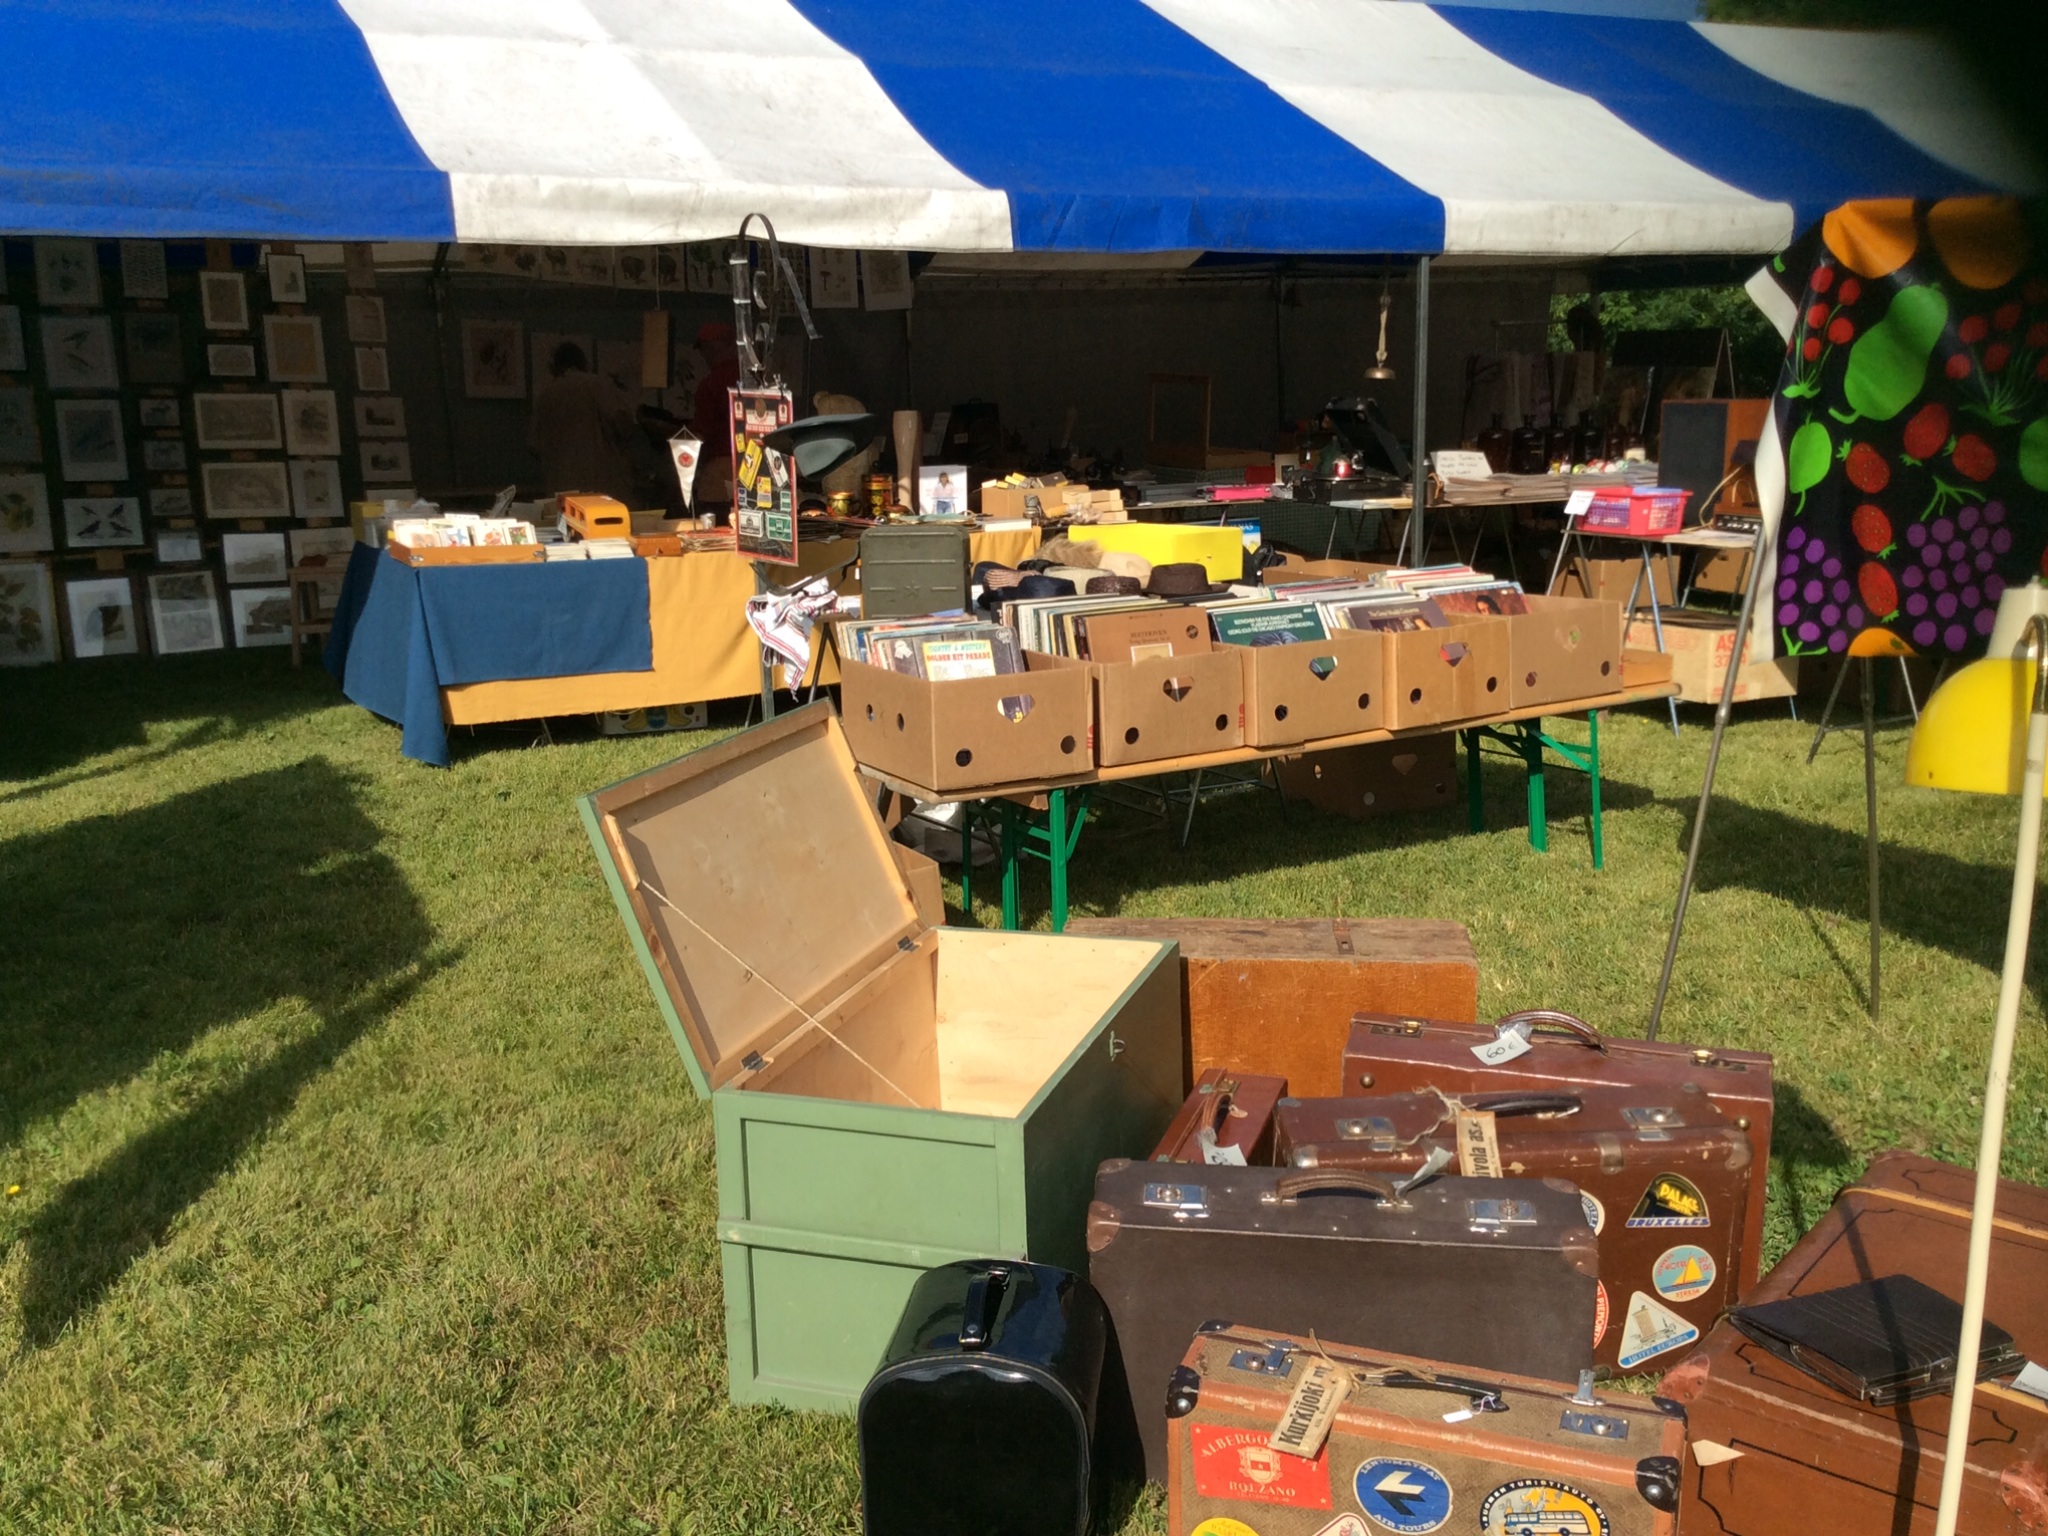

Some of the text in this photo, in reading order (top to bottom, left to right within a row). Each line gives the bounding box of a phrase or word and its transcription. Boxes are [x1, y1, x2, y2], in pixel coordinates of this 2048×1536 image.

[953, 653, 964, 661] HIT
[965, 652, 991, 660] PARADE
[1486, 1046, 1506, 1059] 60
[1469, 1147, 1491, 1176] ivola
[1660, 1183, 1699, 1213] PALACE
[1627, 1218, 1709, 1227] BRUXELLES
[1628, 1334, 1689, 1364] HOTEL EUROPA
[1278, 1381, 1325, 1446] Kurkijoki
[1201, 1433, 1269, 1458] ALBERGO
[1229, 1481, 1296, 1498] BOLZANO
[1482, 1487, 1507, 1522] SUOMEN
[1510, 1480, 1594, 1504] TURISTIAUTO
[1374, 1514, 1437, 1532] AIR TOURS
